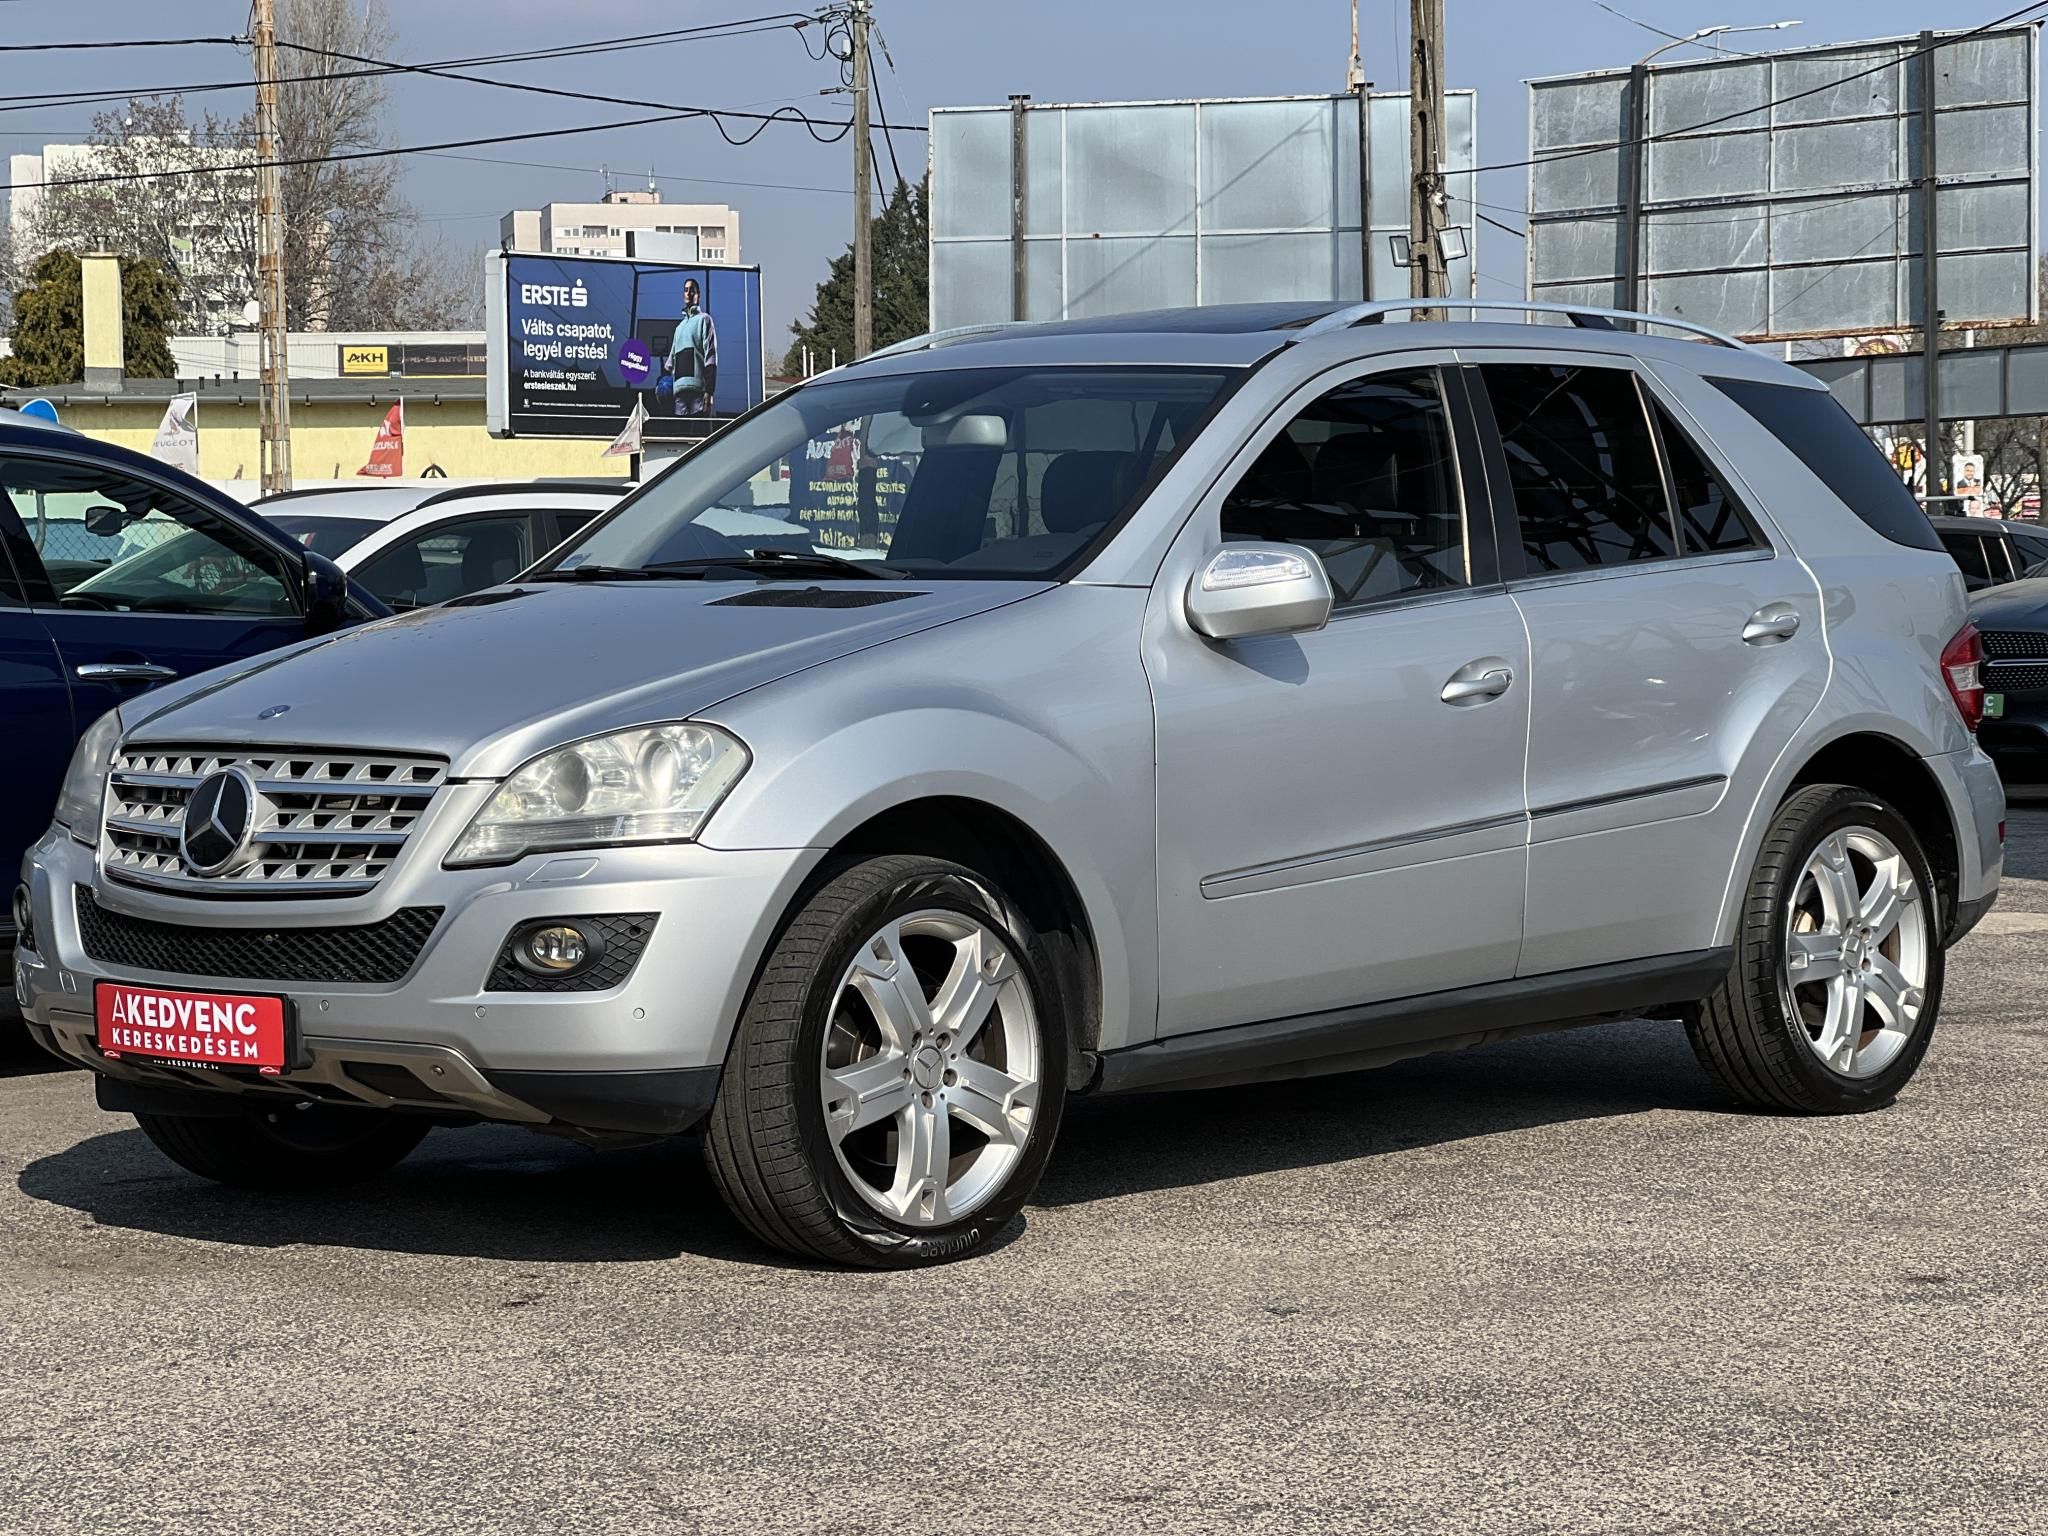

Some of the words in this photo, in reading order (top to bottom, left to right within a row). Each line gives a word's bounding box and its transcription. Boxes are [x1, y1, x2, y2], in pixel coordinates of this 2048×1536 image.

[521, 284, 570, 306] ERSTE
[521, 318, 553, 336] Válts
[556, 323, 615, 342] csapatot,
[346, 353, 384, 363] AKH
[523, 340, 562, 360] legyél
[565, 342, 608, 359] erstés!
[524, 369, 529, 378] A
[530, 369, 564, 379] bankváltás
[524, 381, 577, 391] erstesleszek.hu
[112, 990, 257, 1035] AKEDVENC
[112, 1027, 258, 1058] KERESKEDÉSEM
